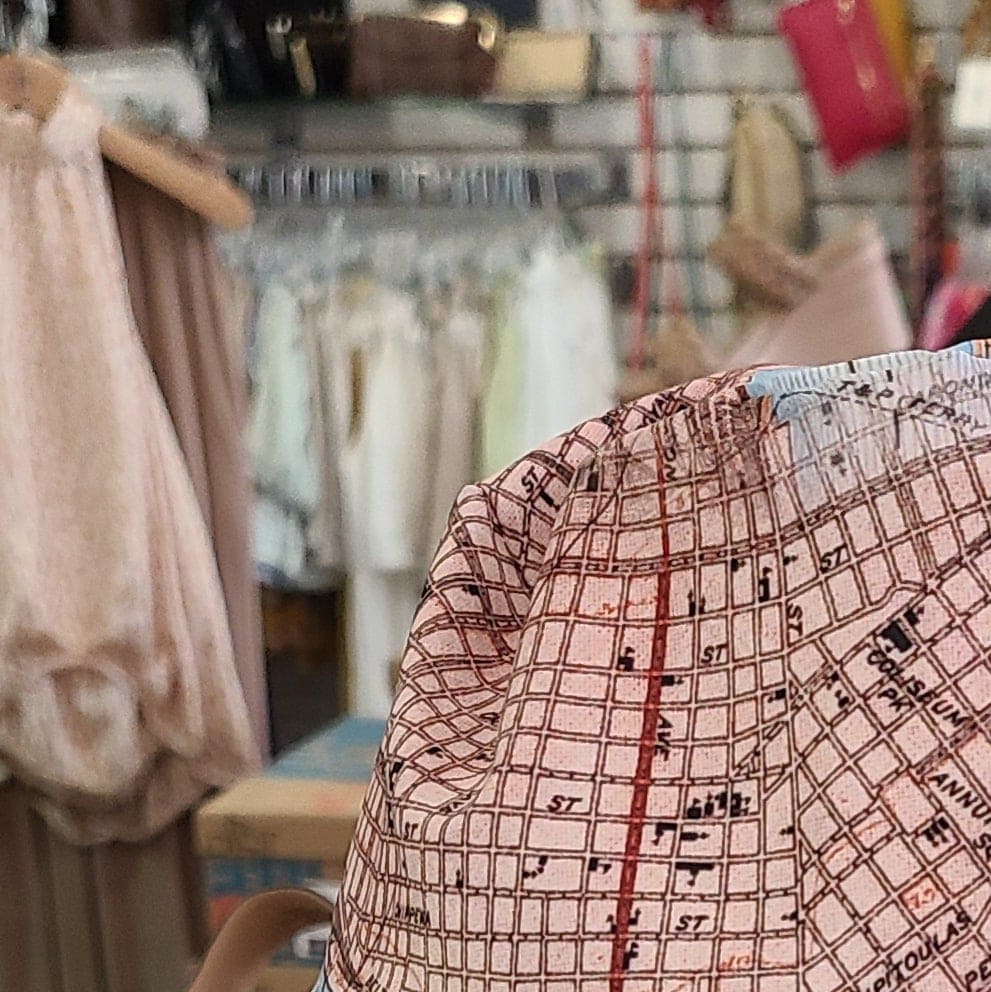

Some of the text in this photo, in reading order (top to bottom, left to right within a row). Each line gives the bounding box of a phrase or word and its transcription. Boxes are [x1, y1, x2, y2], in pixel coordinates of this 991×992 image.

[519, 469, 541, 496] ST
[819, 544, 848, 571] ST
[787, 603, 803, 636] ST
[702, 645, 728, 665] ST
[866, 645, 970, 728] COLISEUM
[877, 687, 914, 712] PK
[655, 714, 673, 762] AVE
[545, 793, 583, 814] ST
[404, 821, 419, 841] ST
[674, 913, 708, 932] ST
